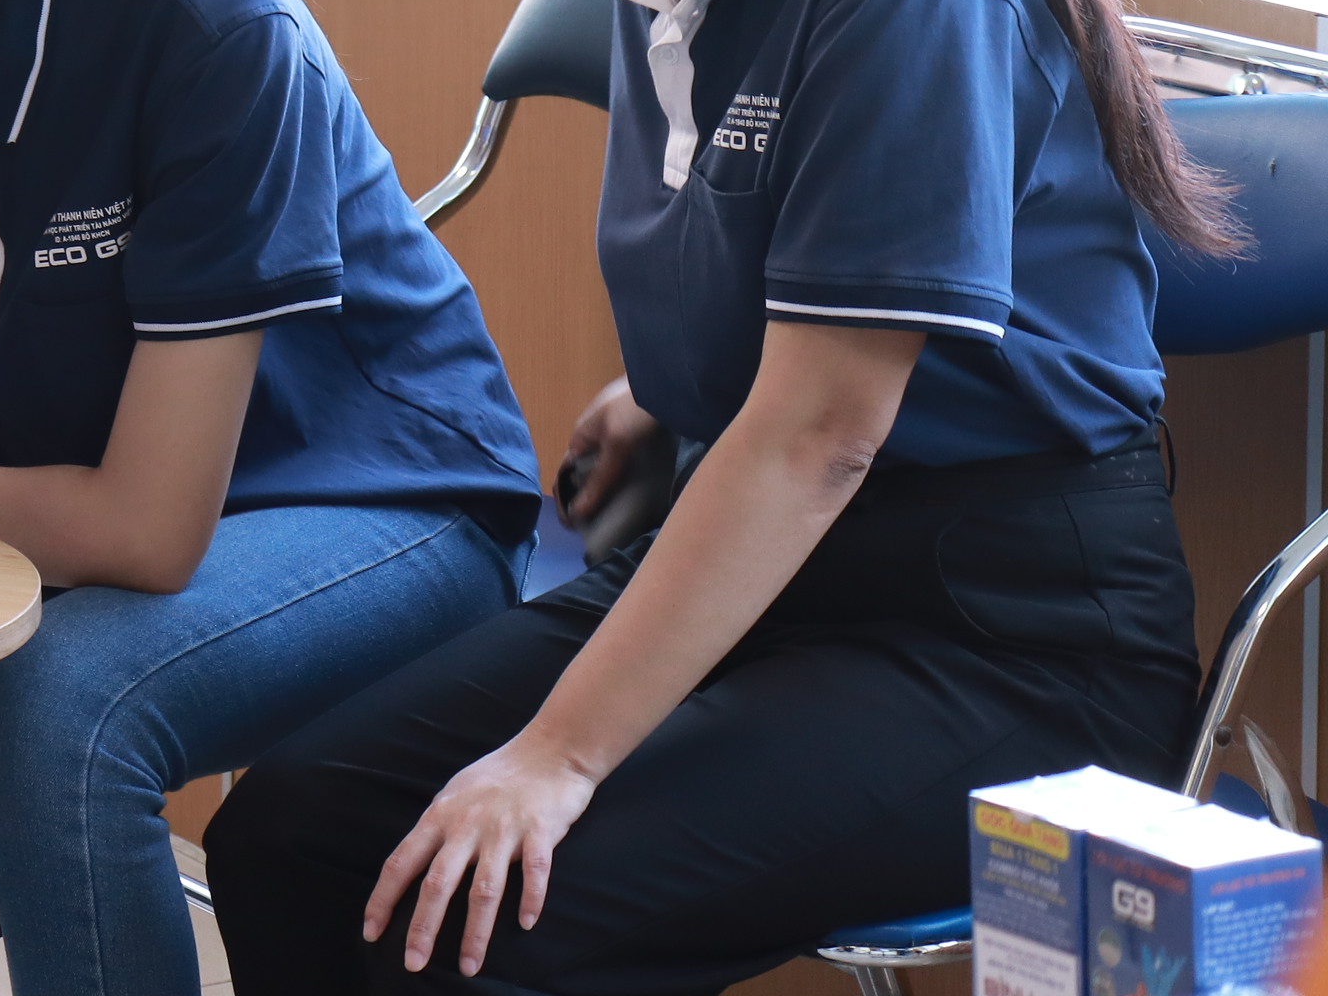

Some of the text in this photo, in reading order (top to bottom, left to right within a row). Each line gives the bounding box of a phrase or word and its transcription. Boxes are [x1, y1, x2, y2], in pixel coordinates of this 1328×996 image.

[713, 128, 768, 152] ECO G
[58, 212, 81, 222] THANH
[83, 207, 104, 220] NIÊN
[106, 201, 126, 215] VIỆT
[34, 246, 87, 268] ECO
[1112, 880, 1155, 926] G9
